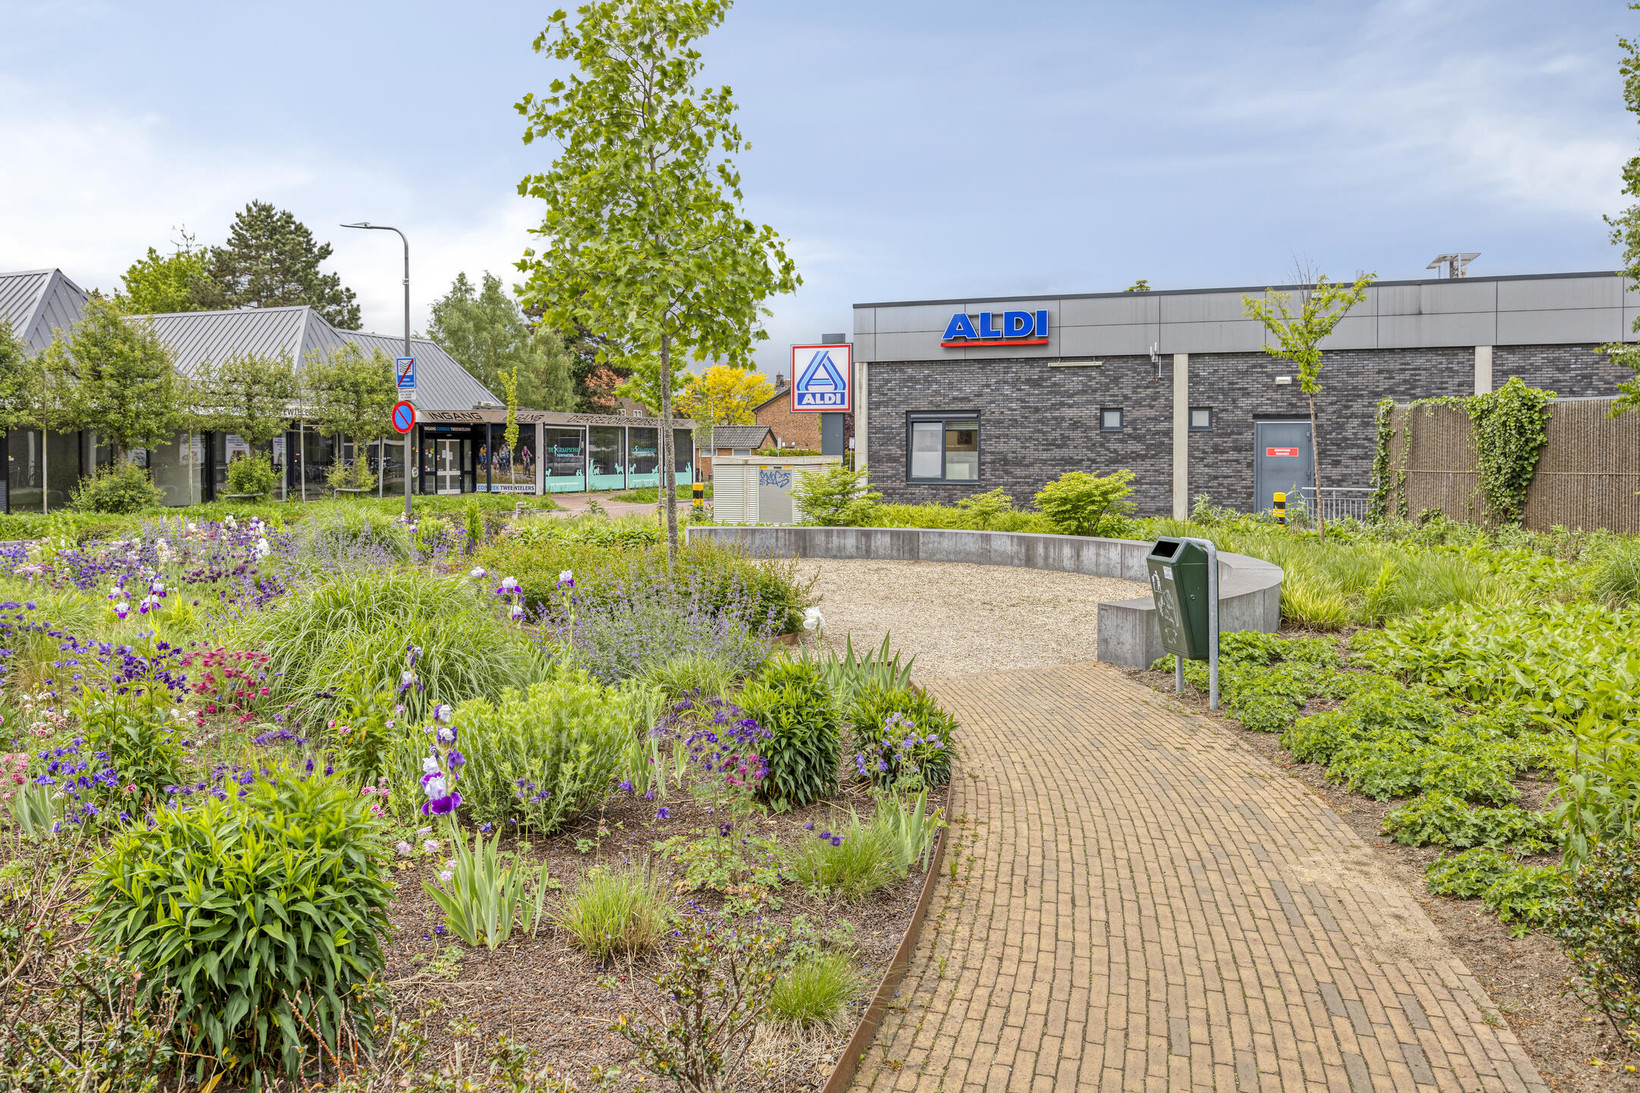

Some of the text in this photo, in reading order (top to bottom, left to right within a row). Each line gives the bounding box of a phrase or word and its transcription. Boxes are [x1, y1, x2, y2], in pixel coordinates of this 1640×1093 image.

[941, 309, 1048, 340] ALDI
[801, 393, 841, 405] ALDI
[428, 412, 483, 420] INGANG
